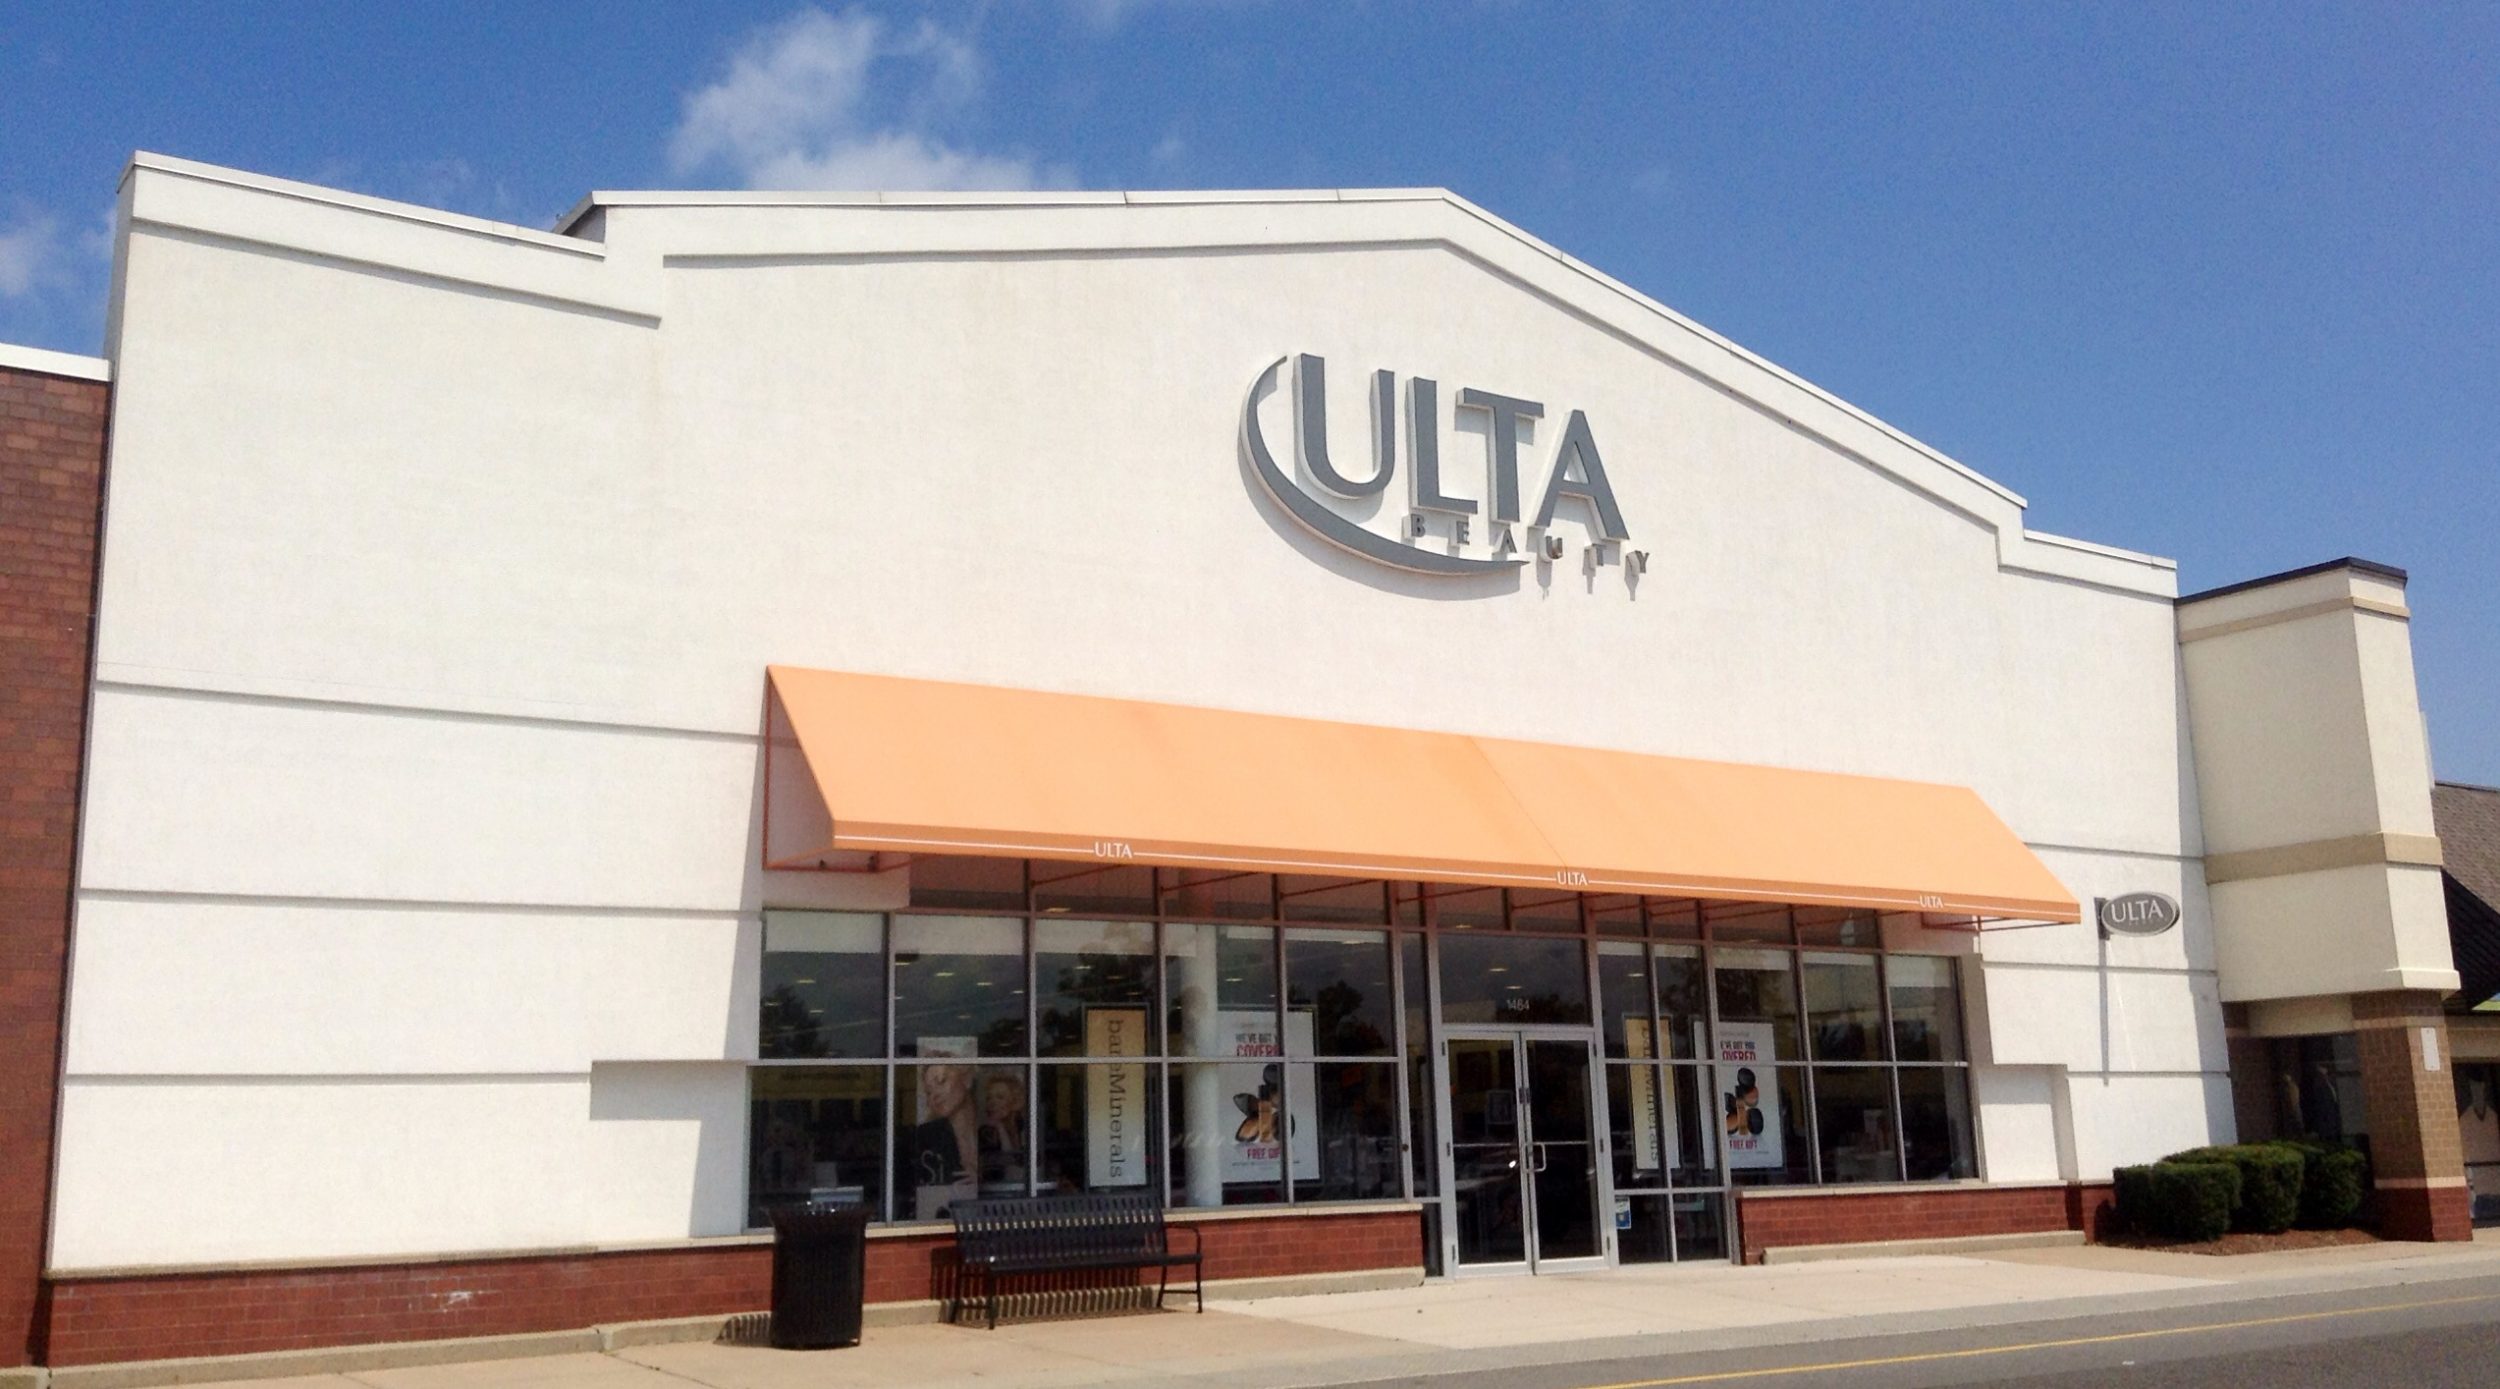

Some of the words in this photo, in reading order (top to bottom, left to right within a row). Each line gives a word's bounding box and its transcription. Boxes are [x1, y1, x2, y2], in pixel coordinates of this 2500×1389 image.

[1294, 353, 1630, 541] ULTA
[1405, 513, 1650, 574] BEAUTY
[1094, 842, 1133, 859] ULTA
[1557, 871, 1588, 886] ULTA
[1920, 894, 1943, 909] ULTA
[2110, 899, 2164, 923] ULTA
[1722, 1050, 1756, 1061] OVERED
